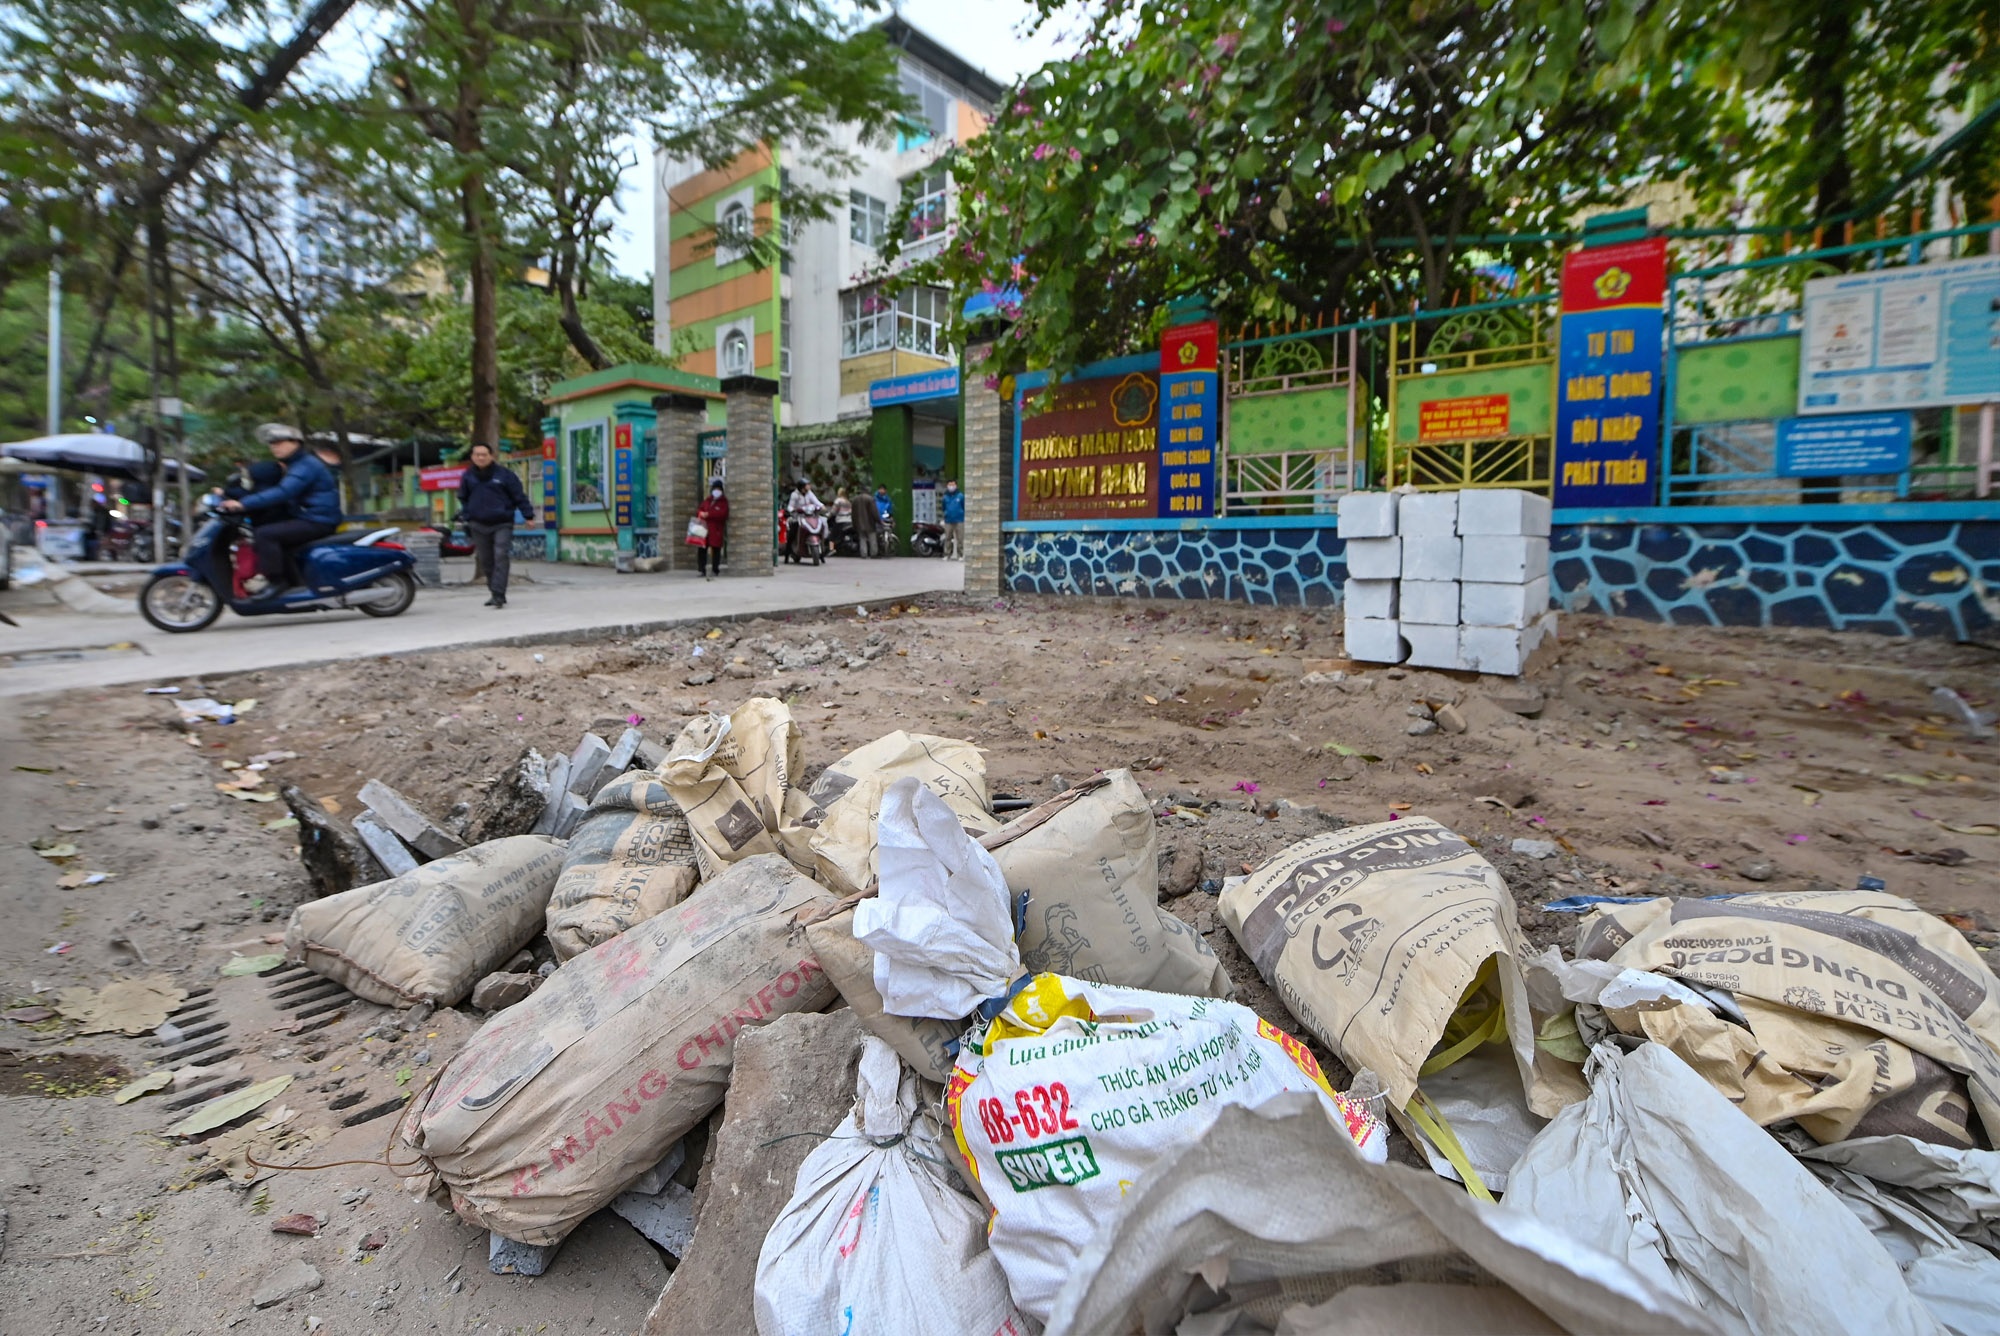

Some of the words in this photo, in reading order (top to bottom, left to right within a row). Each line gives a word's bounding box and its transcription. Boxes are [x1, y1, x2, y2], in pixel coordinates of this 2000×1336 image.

[1588, 331, 1606, 357] TỰ
[1611, 331, 1635, 354] TIN
[1609, 371, 1652, 400] ĐỘNG
[1572, 417, 1598, 444] HỘI
[1601, 414, 1642, 443] NHẬP
[1022, 430, 1079, 461] TRƯỜNG
[1080, 427, 1121, 456] MẦM
[1122, 427, 1157, 453] NON
[1026, 464, 1096, 502] QUỲNH
[1100, 462, 1147, 496] MAI
[1563, 458, 1601, 486] PHÁT
[1604, 451, 1648, 486] TRIỂN
[1096, 856, 1118, 884] 226
[1366, 862, 1411, 874] TCVN
[1110, 885, 1129, 908] HT
[1254, 884, 1266, 897] XI
[1274, 859, 1345, 920] DÂN
[1421, 882, 1492, 899] VICEM
[1286, 875, 1356, 936] PCB30
[1128, 936, 1151, 955] SỐ
[1335, 917, 1383, 982] VIBM
[1433, 940, 1450, 957] SỐ
[1663, 937, 1734, 949] 6260:2009
[1735, 935, 1772, 947] TCVN
[1380, 977, 1402, 1018] KHỐI
[1401, 924, 1450, 974] LƯỢNG
[1670, 946, 1775, 970] PCB30
[1705, 972, 1741, 982] OHSAS
[1781, 947, 1908, 1002] DỤNG
[1834, 989, 1888, 1011] SƠN
[1009, 1047, 1047, 1067] Lựa
[1051, 1034, 1101, 1057] chọn
[1098, 1064, 1144, 1093] THỨC
[1145, 1063, 1166, 1086] ĂN
[1168, 1045, 1202, 1078] HỖN
[1201, 1035, 1227, 1064] HỢP
[511, 1162, 540, 1198] XI
[549, 1068, 669, 1172] MĂNG
[676, 954, 826, 1072] CHINFON
[1090, 1108, 1126, 1132] CHO
[1128, 1095, 1154, 1124] GÀ
[1152, 1086, 1200, 1120] TRẮNG
[1199, 1072, 1218, 1102] TỪ
[1218, 1069, 1235, 1091] 14
[1001, 1141, 1095, 1188] SUPER
